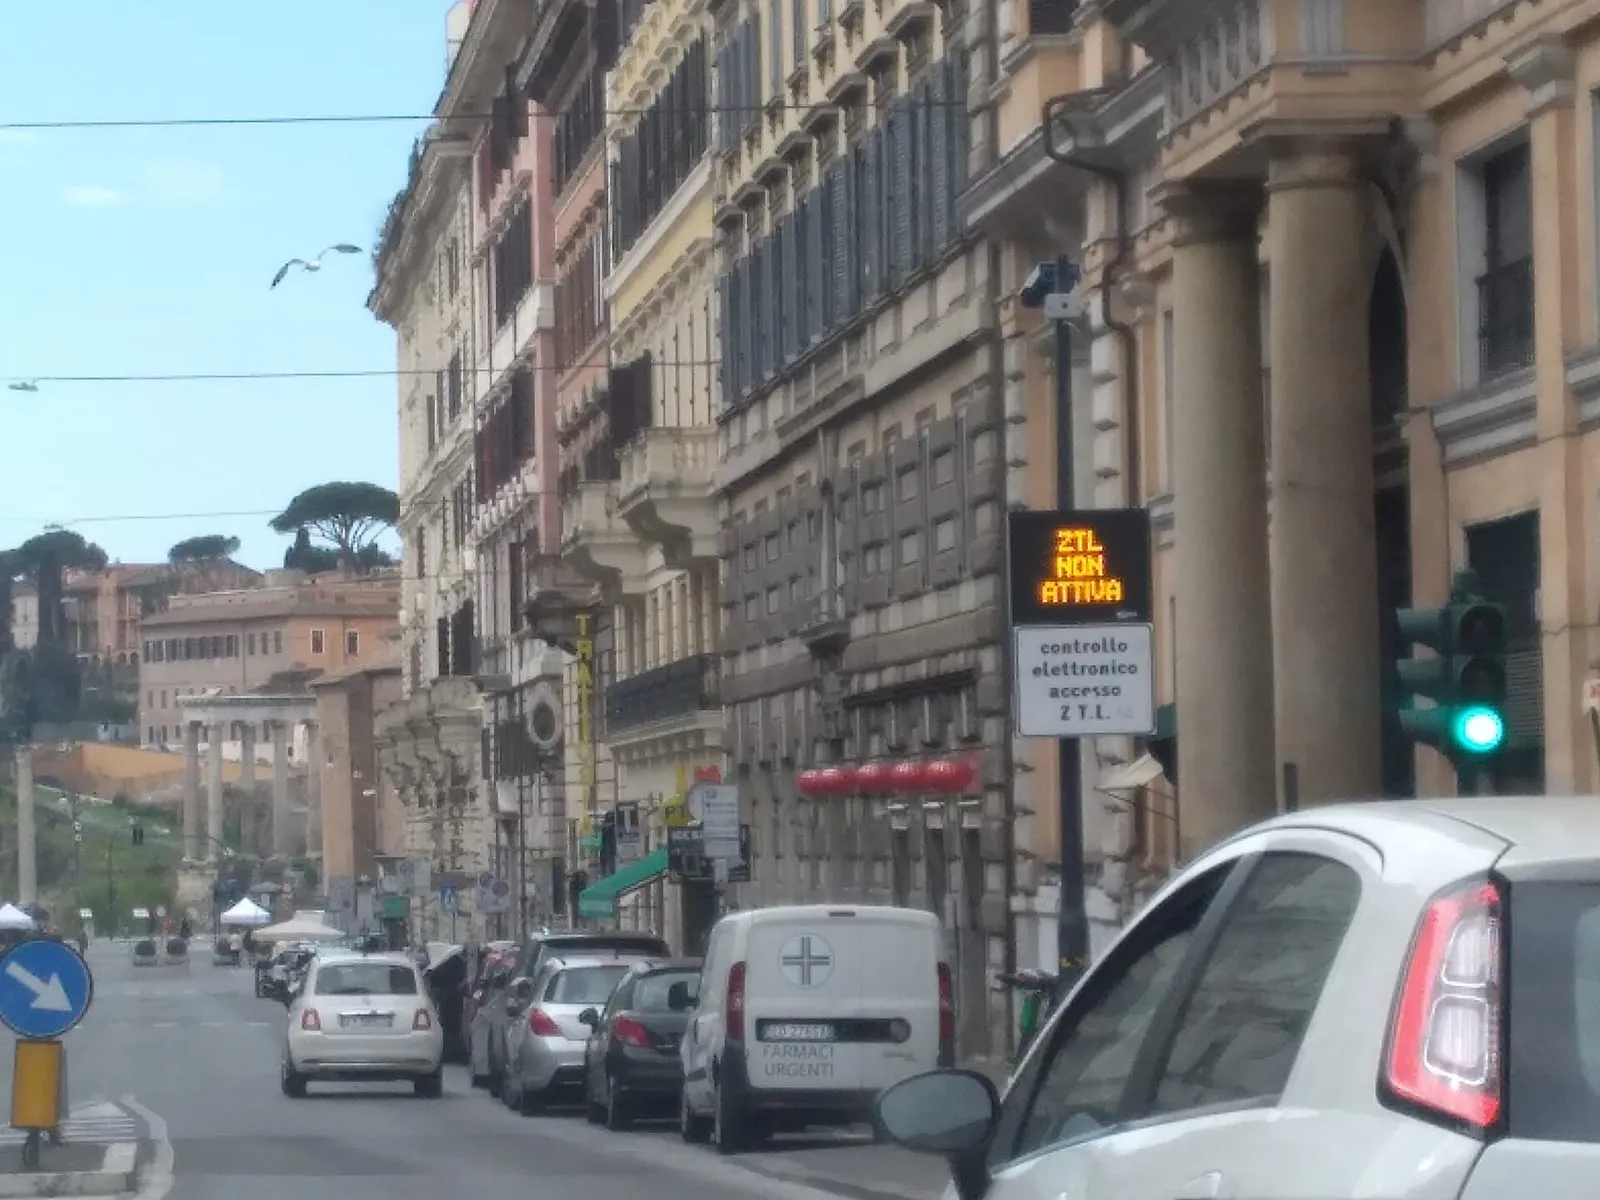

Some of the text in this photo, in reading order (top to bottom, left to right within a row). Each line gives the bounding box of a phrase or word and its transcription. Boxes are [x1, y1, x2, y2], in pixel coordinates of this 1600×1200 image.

[1056, 528, 1104, 552] ZTL
[1056, 554, 1104, 577] NON
[1041, 579, 1123, 603] ATTIVA
[1040, 637, 1128, 654] controllo
[1032, 659, 1138, 677] elettronico
[1049, 685, 1121, 699] accesso
[763, 1044, 834, 1059] FARMACI
[765, 1062, 834, 1077] URGENTI
